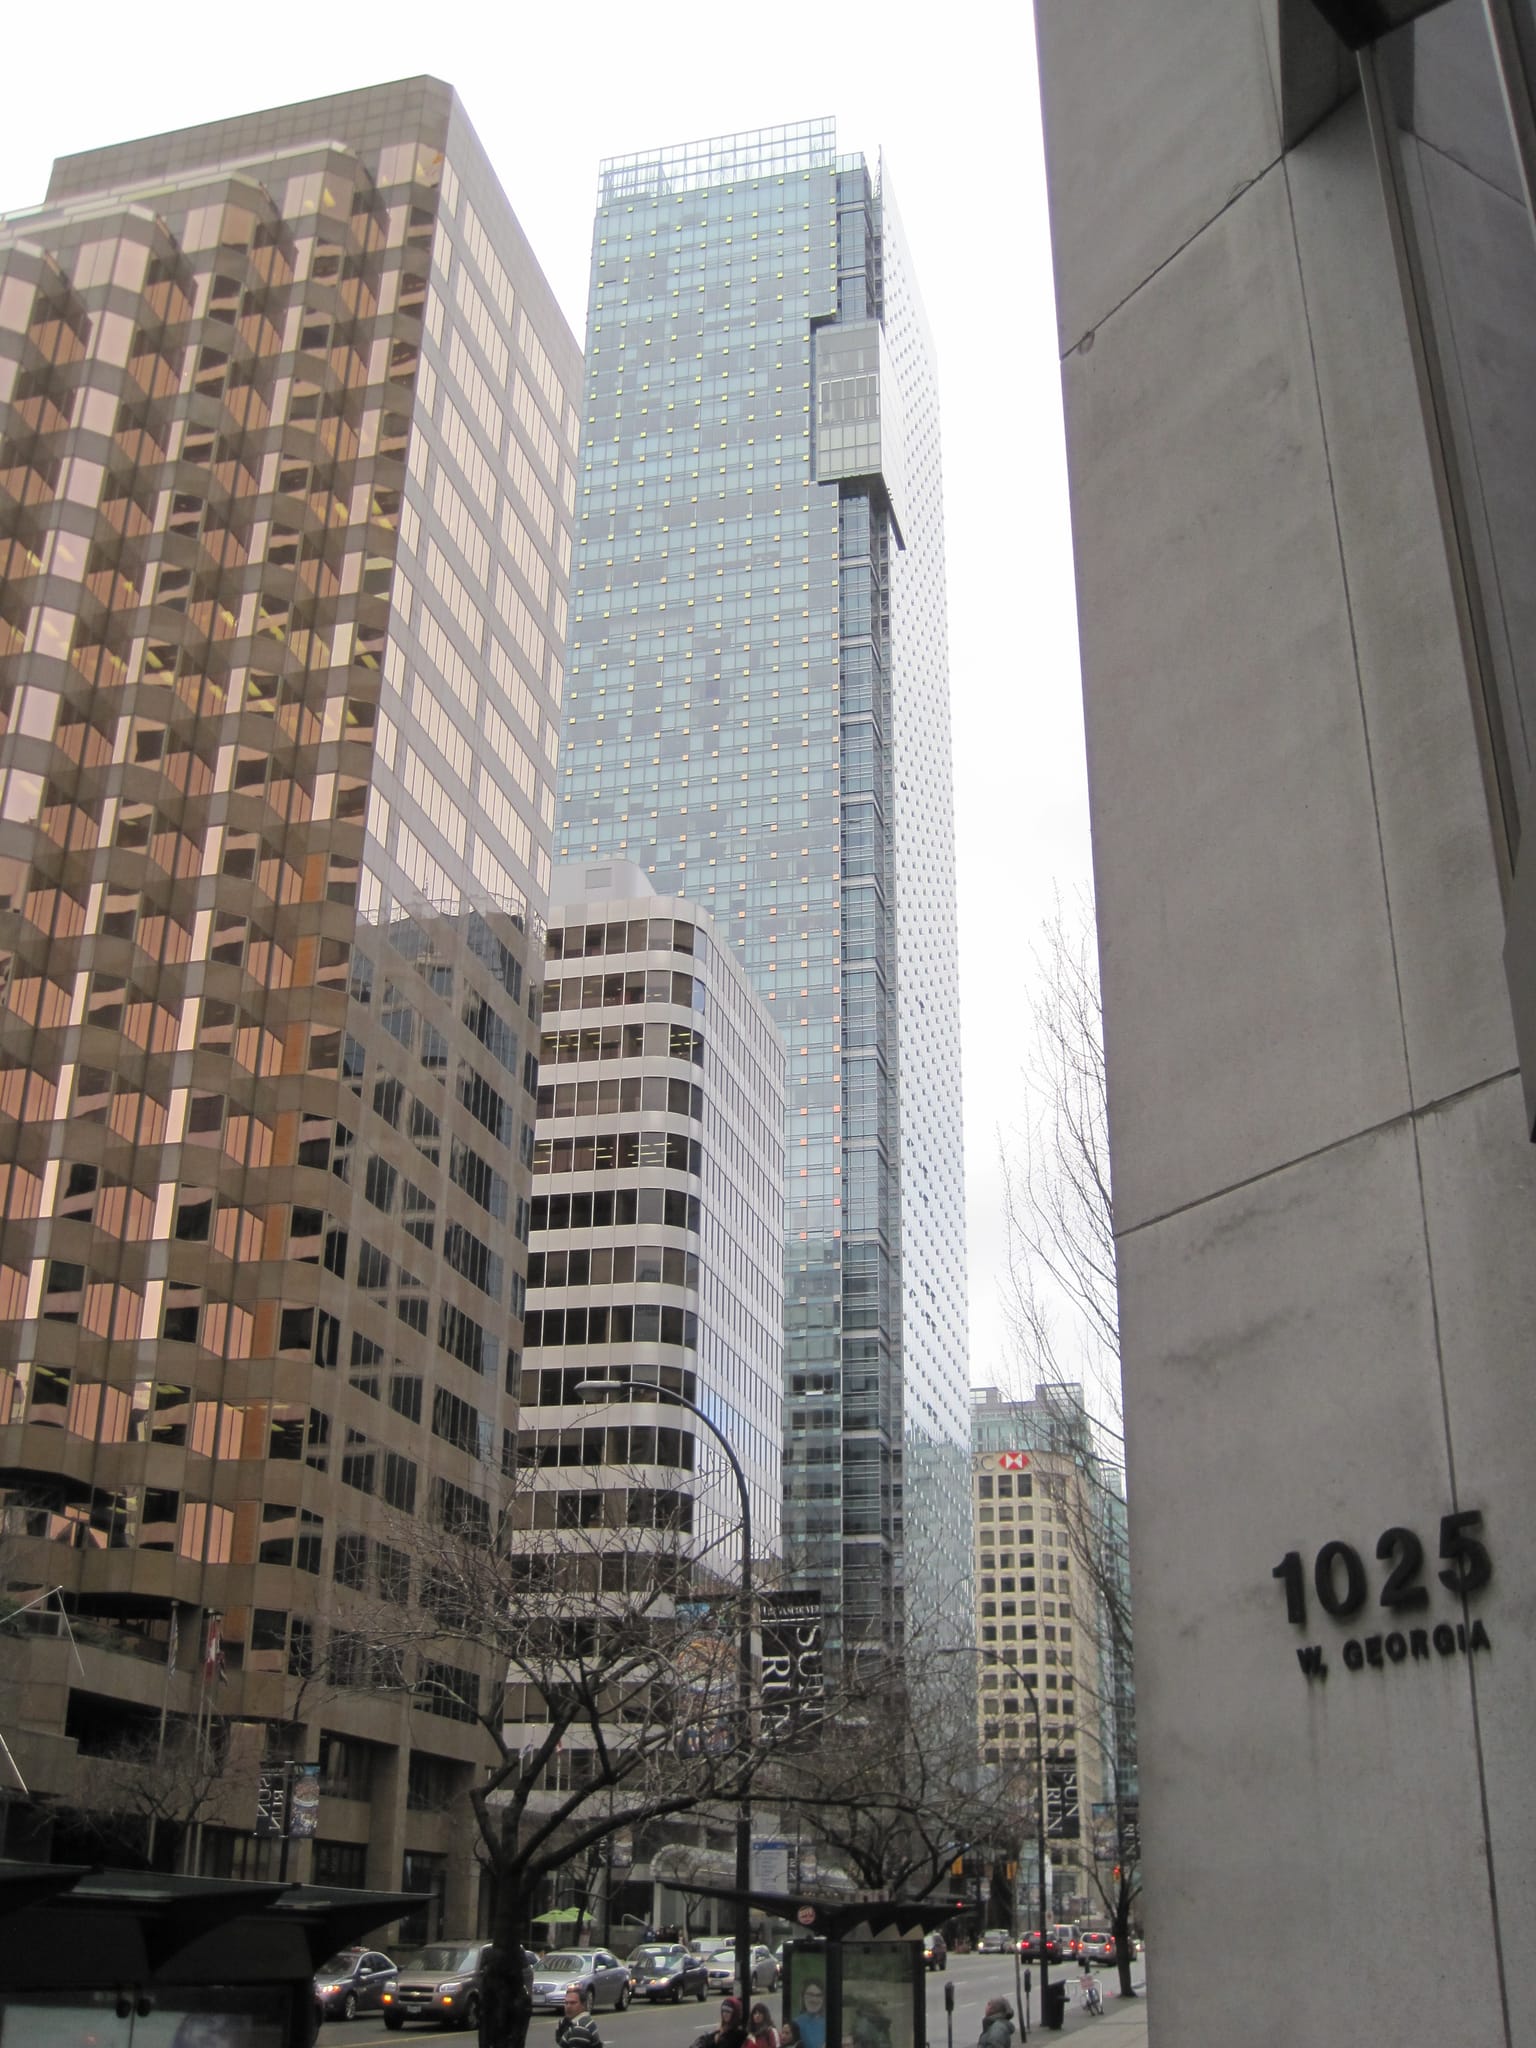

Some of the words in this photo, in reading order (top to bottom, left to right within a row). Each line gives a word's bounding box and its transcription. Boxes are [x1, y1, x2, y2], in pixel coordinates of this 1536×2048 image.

[1272, 1510, 1492, 1624] 1025
[796, 1625, 826, 1711] SUN
[1297, 1646, 1328, 1678] W.
[1343, 1620, 1491, 1671] GEORGIA
[760, 1655, 791, 1740] RUN
[1047, 1788, 1063, 1831] RUN
[1063, 1773, 1080, 1817] SUN
